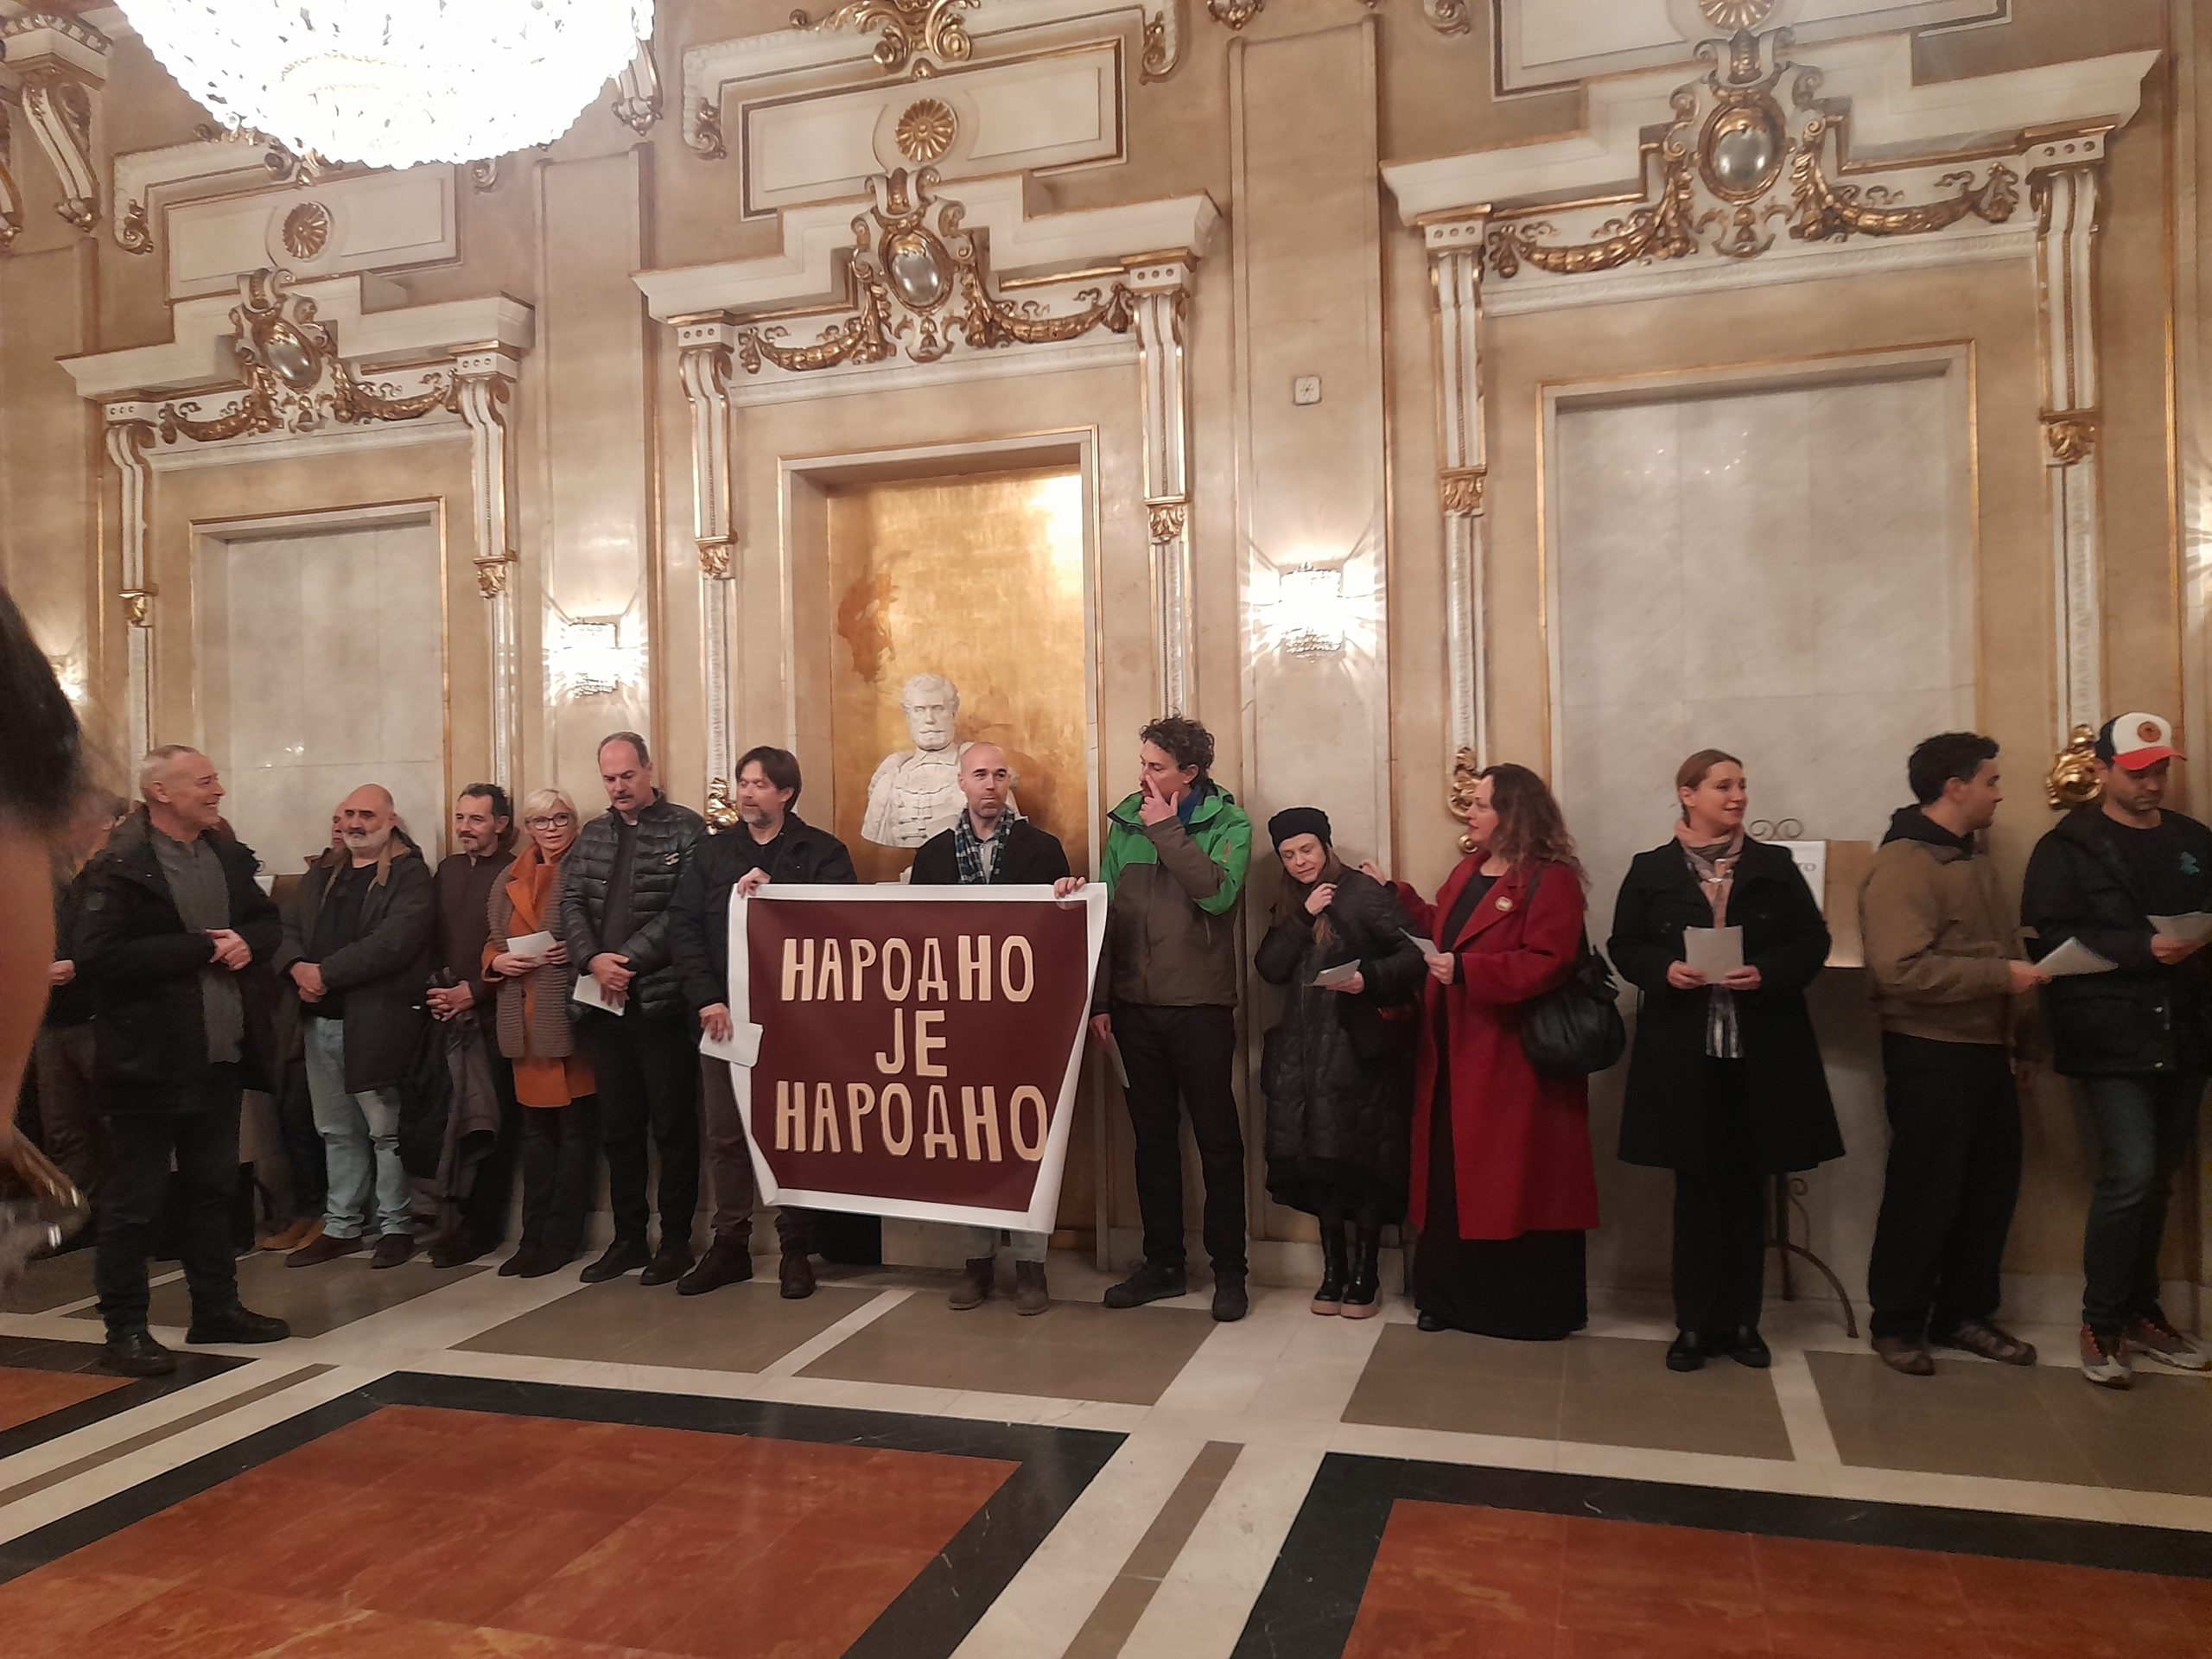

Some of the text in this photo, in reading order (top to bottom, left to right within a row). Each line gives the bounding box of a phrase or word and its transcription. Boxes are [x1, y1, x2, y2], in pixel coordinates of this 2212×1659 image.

[781, 935, 1034, 1002] НАРОДНО
[875, 1007, 948, 1077] ЈЕ
[774, 1080, 1048, 1162] НАРОДНО
